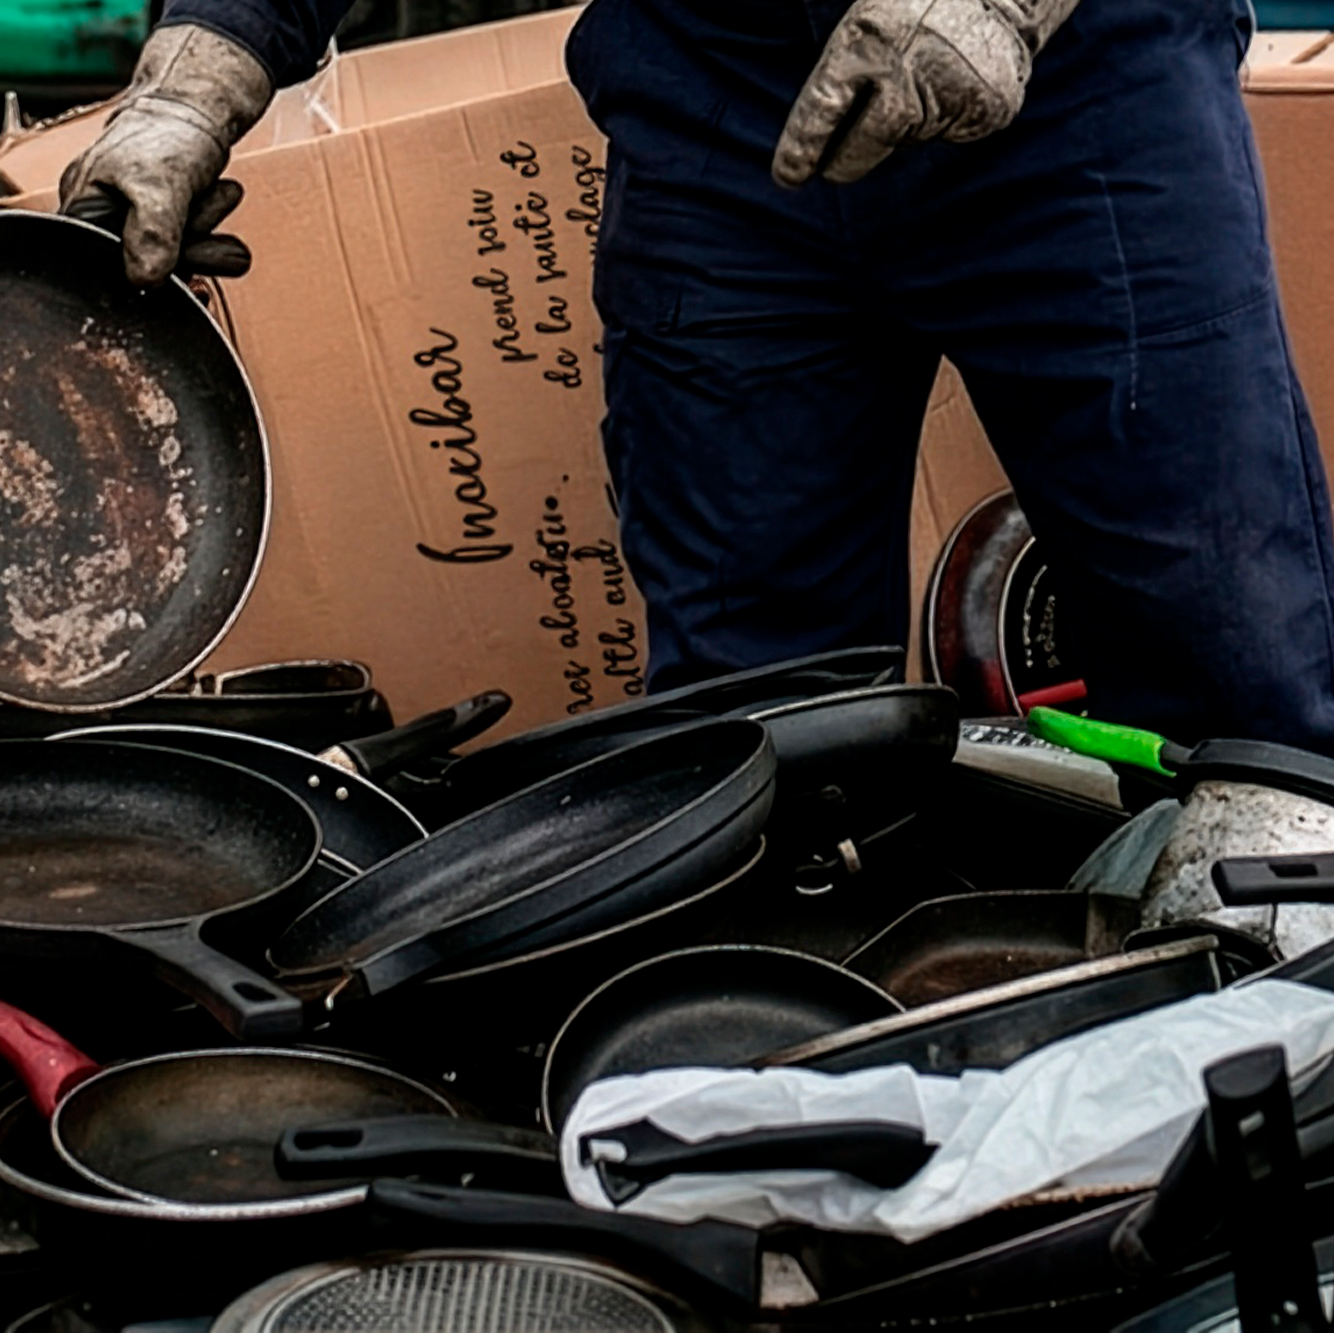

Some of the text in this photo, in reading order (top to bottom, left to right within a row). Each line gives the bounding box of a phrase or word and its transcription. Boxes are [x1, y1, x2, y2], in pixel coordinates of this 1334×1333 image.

[500, 141, 540, 178] et
[473, 268, 538, 362] prend
[535, 296, 571, 334] la
[544, 348, 582, 388] de
